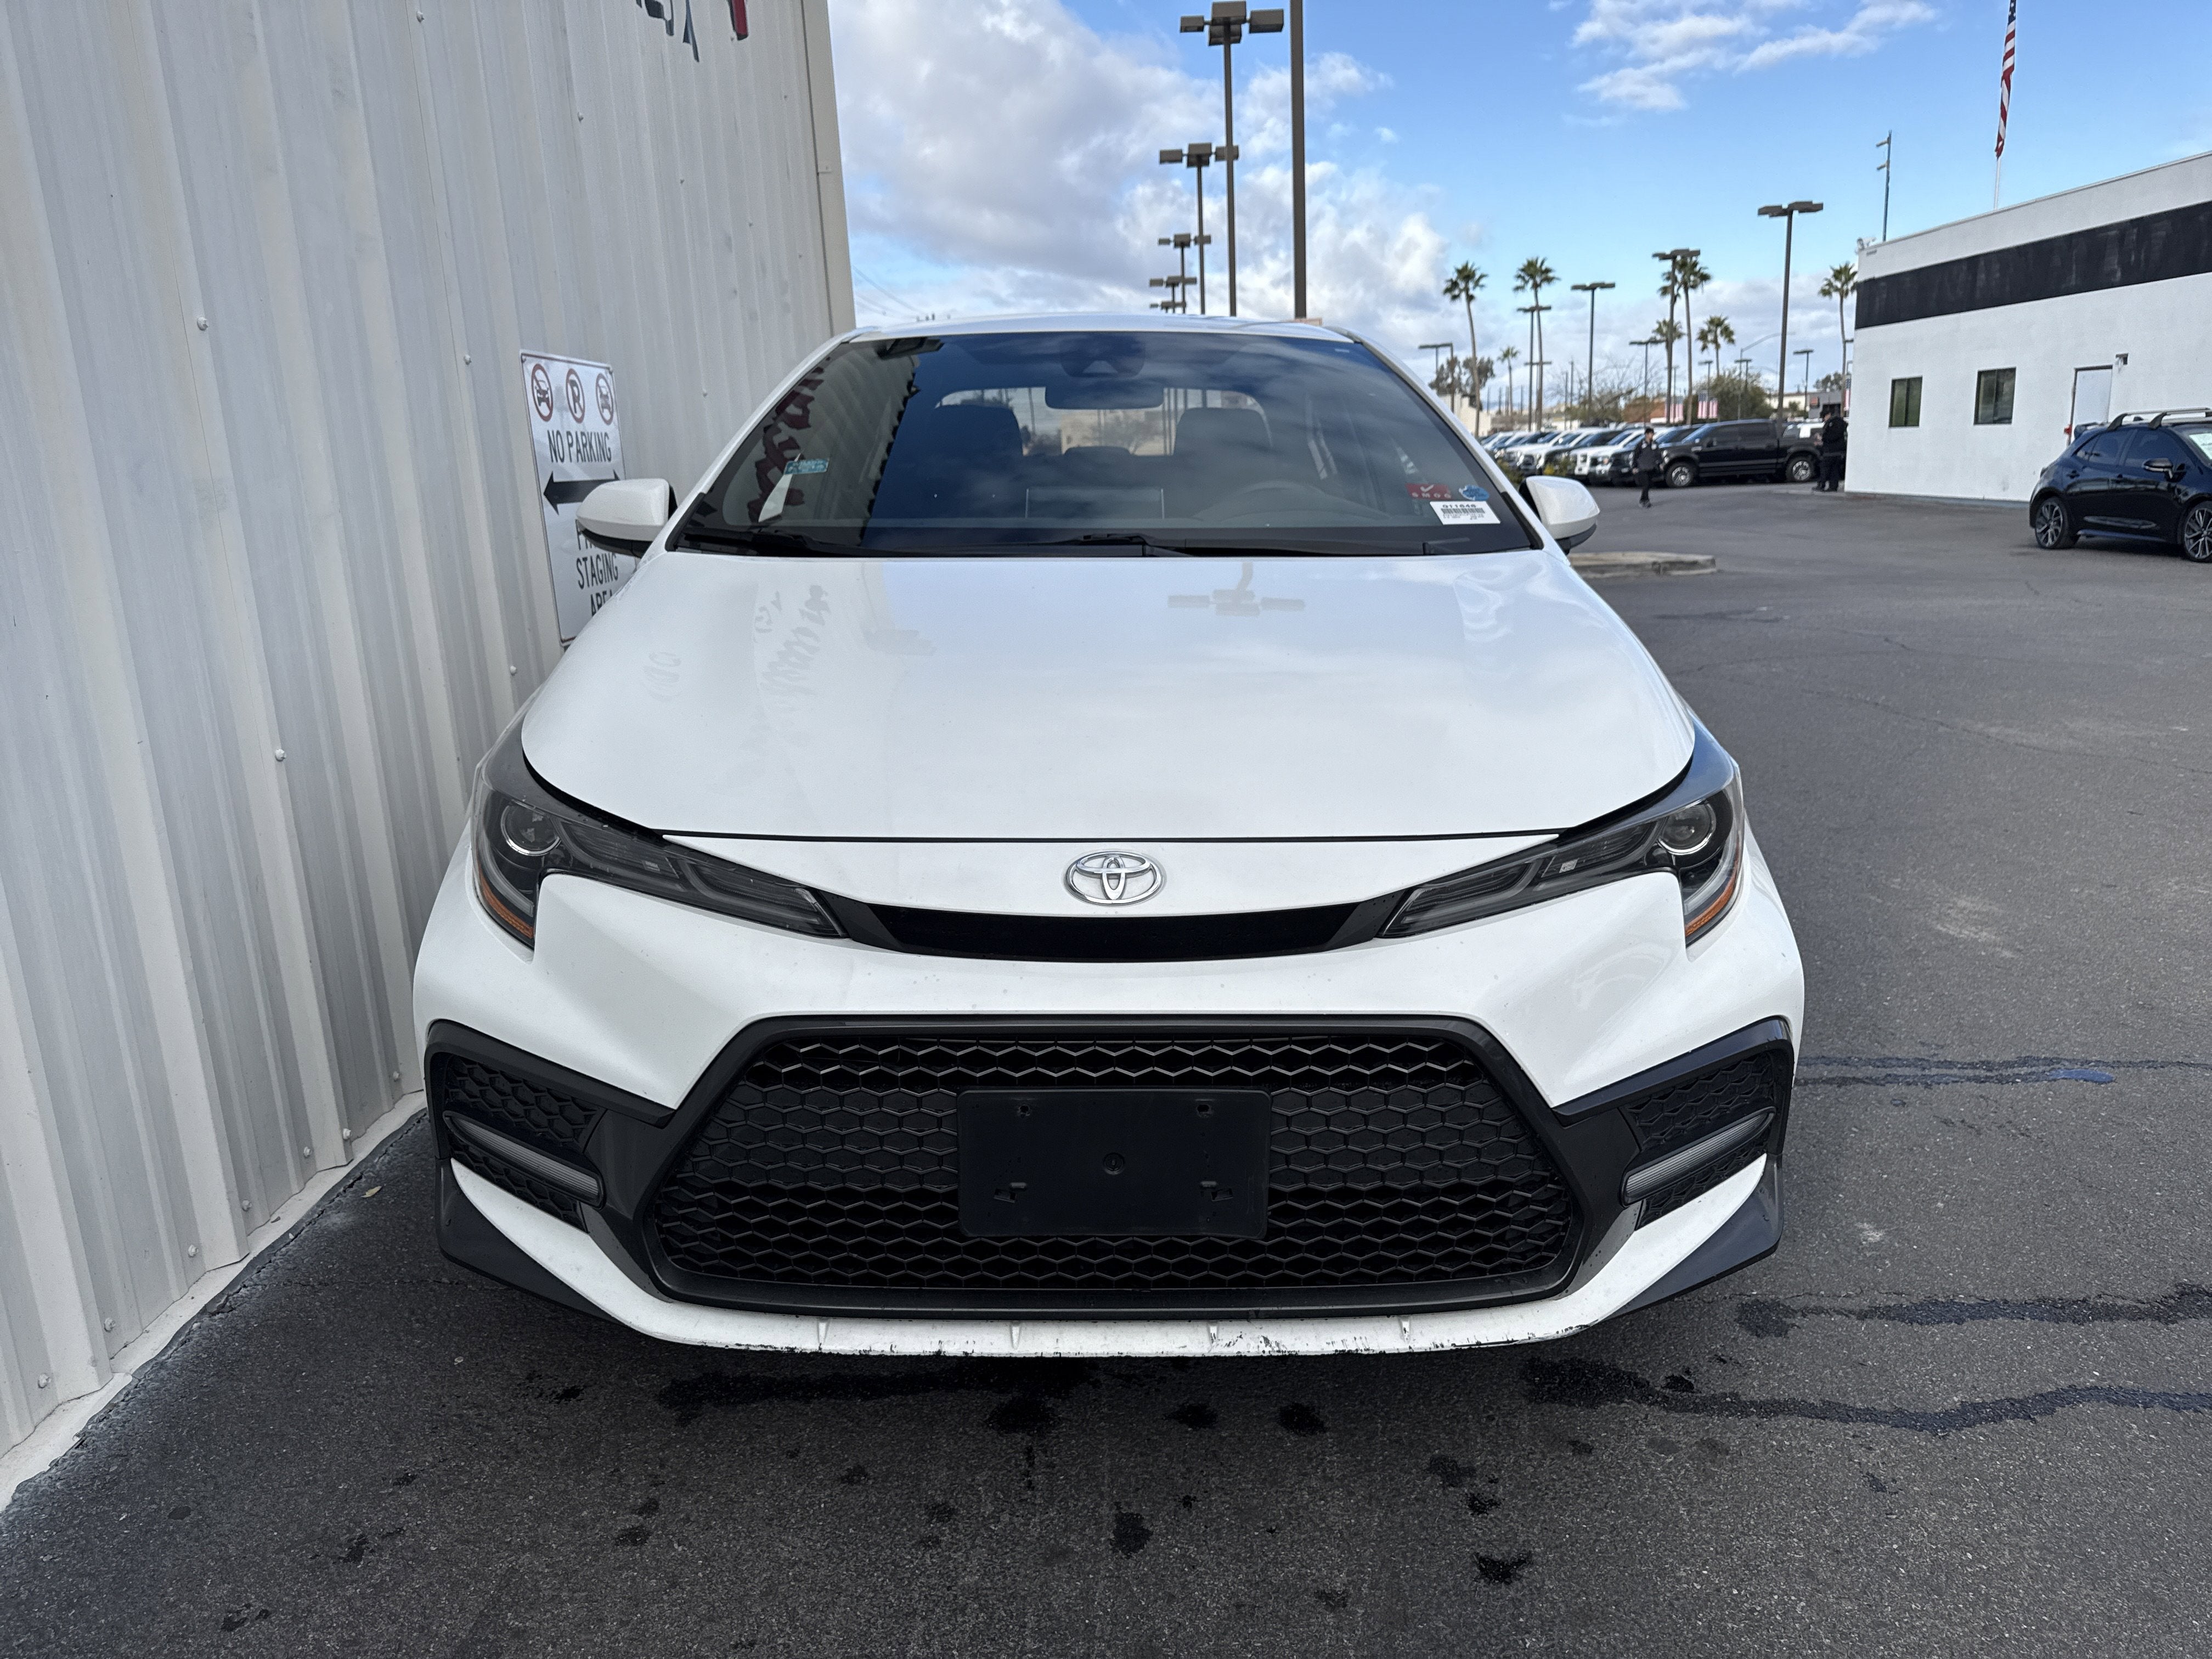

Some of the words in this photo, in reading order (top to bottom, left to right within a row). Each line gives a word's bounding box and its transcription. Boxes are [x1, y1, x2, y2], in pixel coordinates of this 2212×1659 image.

[547, 430, 565, 463] NO
[566, 431, 612, 463] PARKING
[576, 552, 619, 590] STAGING
[590, 589, 612, 617] AR
